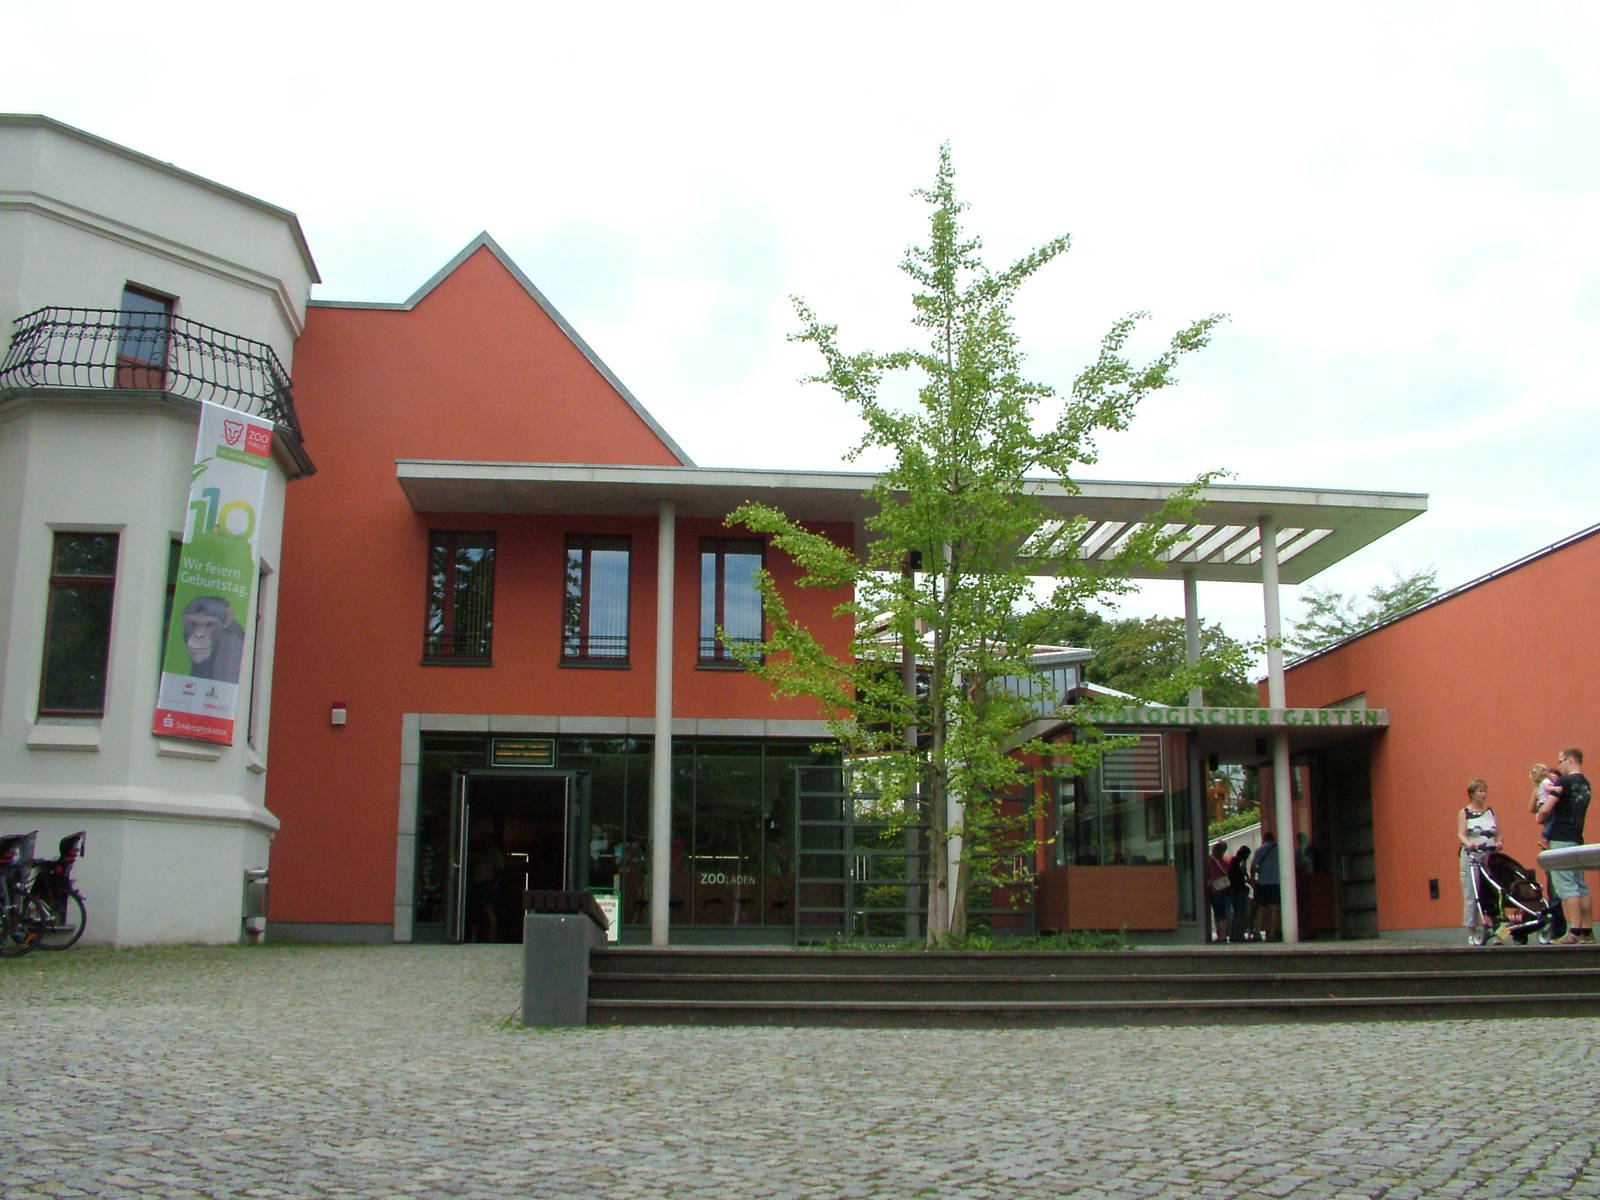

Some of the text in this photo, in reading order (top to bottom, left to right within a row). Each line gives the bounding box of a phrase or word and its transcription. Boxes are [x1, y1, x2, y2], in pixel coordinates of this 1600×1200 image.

[183, 556, 241, 579] Wir feiern
[1283, 708, 1378, 726] GARTEN
